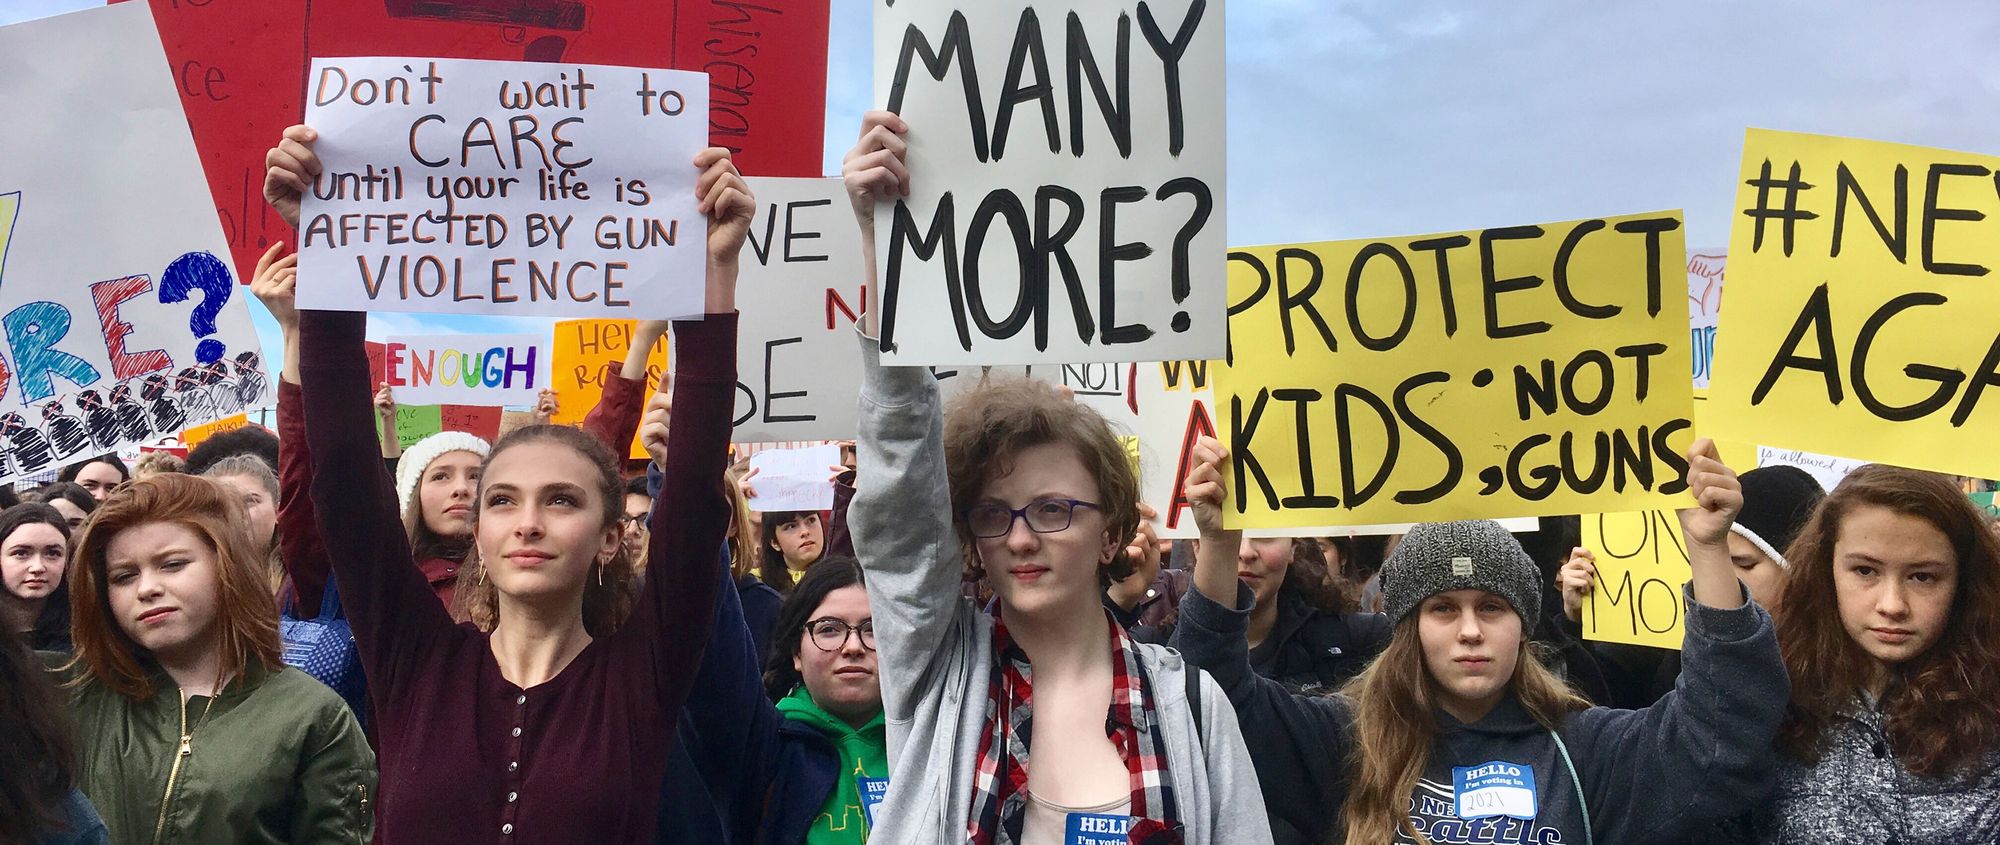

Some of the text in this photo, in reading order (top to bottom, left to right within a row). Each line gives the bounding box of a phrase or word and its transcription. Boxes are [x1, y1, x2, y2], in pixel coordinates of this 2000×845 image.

[315, 62, 686, 116] Don't wait to
[887, 0, 1207, 163] MANY
[409, 114, 594, 171] CARE
[312, 163, 651, 224] until your life is
[1743, 157, 2000, 277] #NE
[304, 211, 679, 251] AFFECTED BY GUN
[356, 254, 632, 307] VIOLENCE
[880, 177, 1213, 353] MORE?
[1227, 217, 1681, 368] PROTECT
[0, 250, 233, 408] RE?
[386, 342, 536, 389] ENOUGH
[1514, 343, 1668, 420] NOT
[1505, 418, 1692, 501] GUNS
[1465, 777, 1524, 790] I'm voting in
[1465, 791, 1505, 812] 2021
[1466, 765, 1521, 781] HELLO
